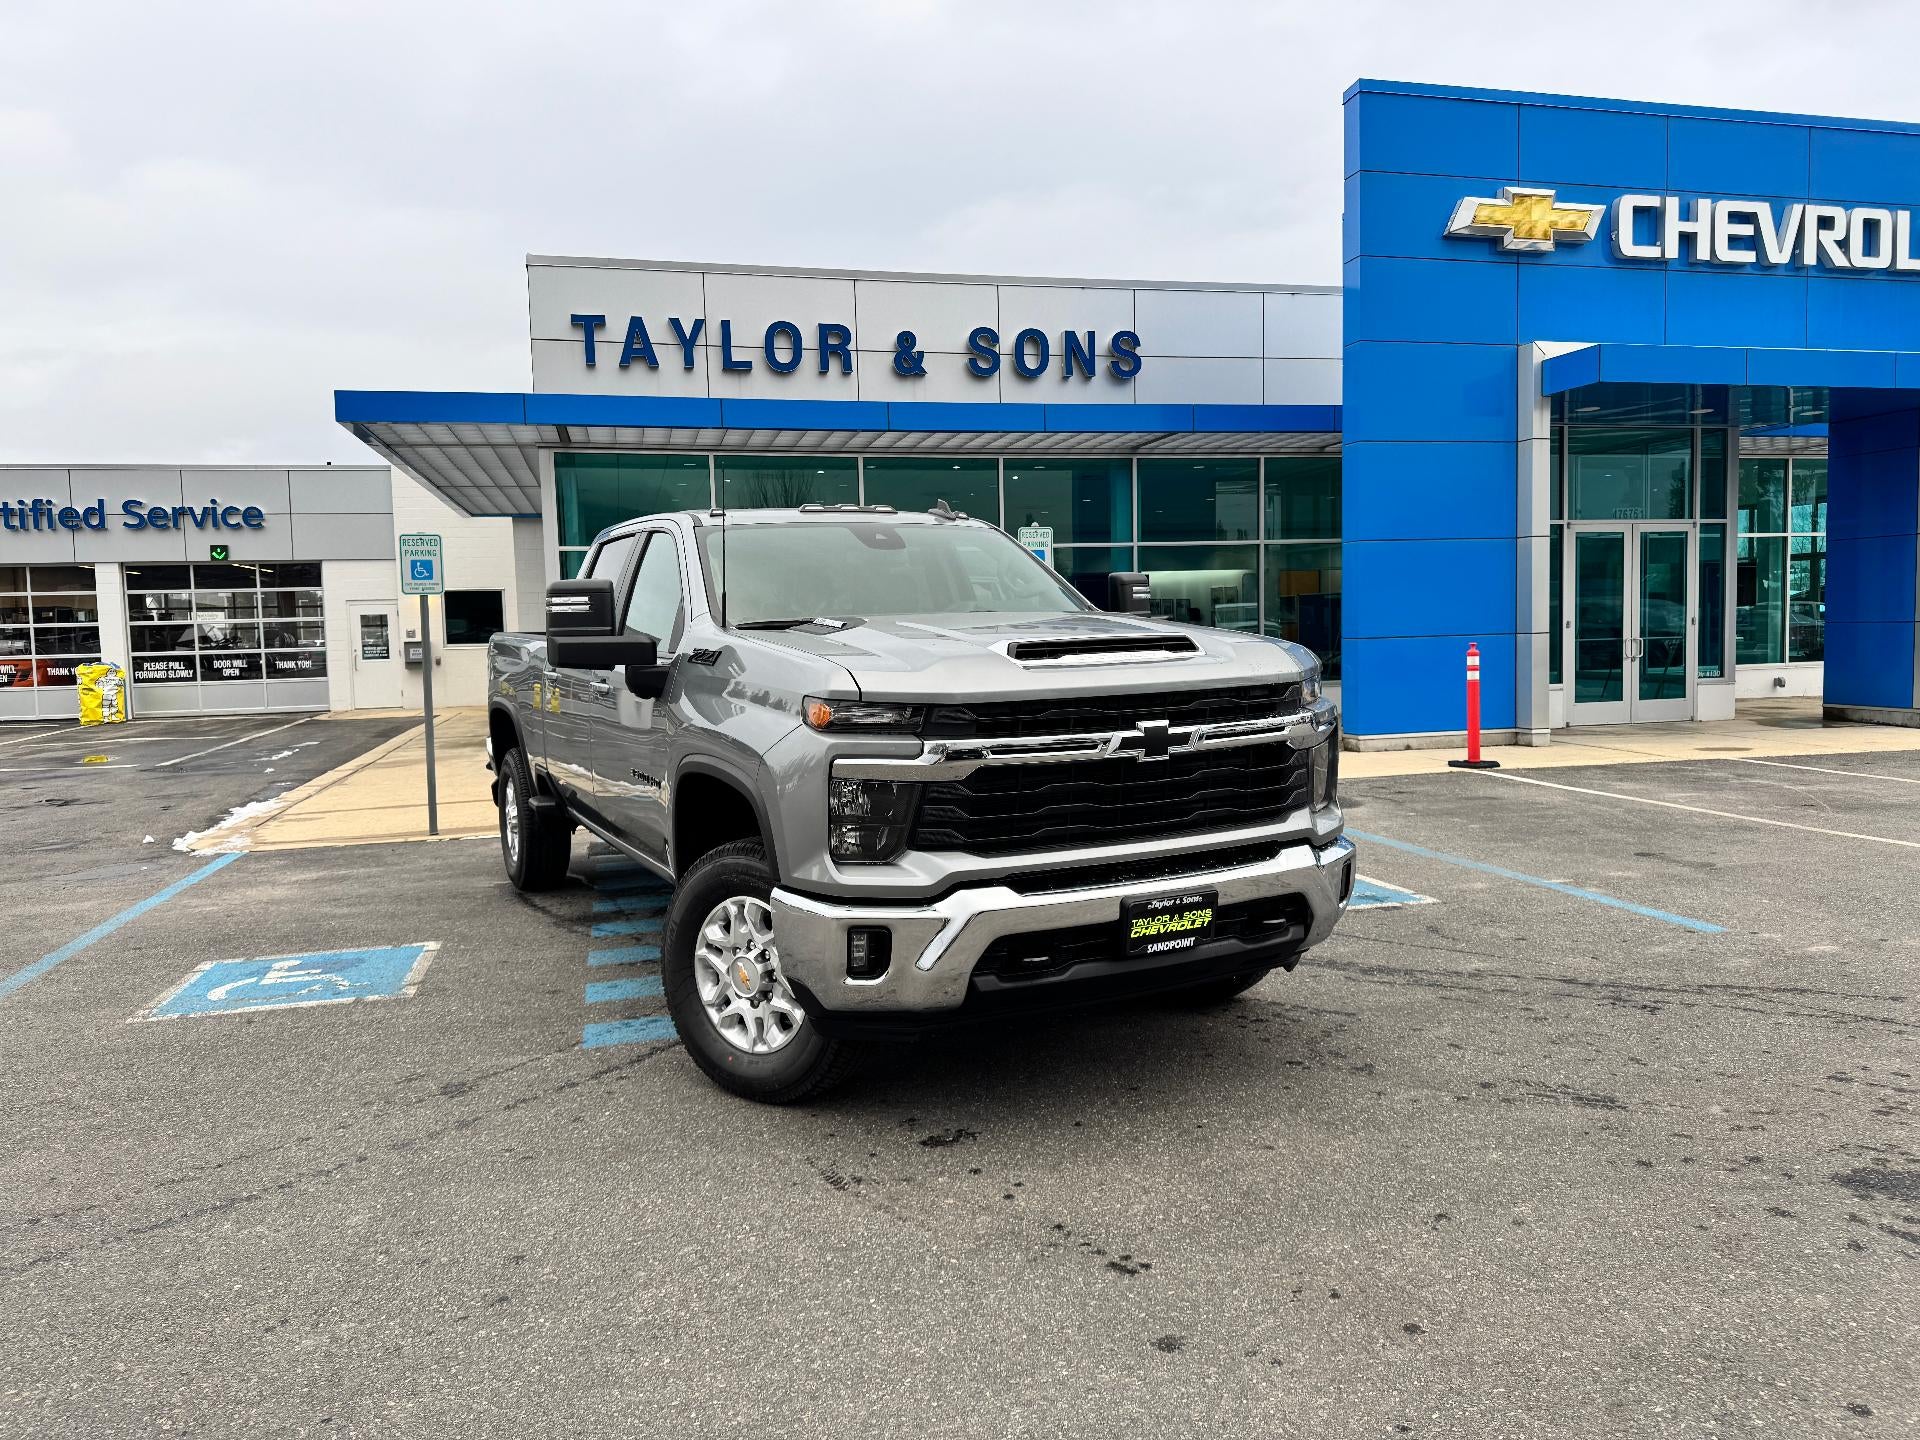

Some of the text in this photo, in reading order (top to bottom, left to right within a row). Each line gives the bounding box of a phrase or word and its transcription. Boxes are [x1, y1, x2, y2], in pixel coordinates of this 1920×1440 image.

[1611, 193, 1920, 270] CHEVROL
[570, 313, 1143, 379] TAYLOR & SONS
[0, 498, 265, 531] tified Service
[1021, 531, 1050, 539] RESERVED
[402, 538, 439, 547] RESERVED
[404, 549, 437, 557] PARKING
[143, 661, 186, 671] PLEASE PULL
[213, 659, 248, 669] DOOR WILL
[275, 660, 312, 669] THANK YOU!
[46, 667, 70, 676] THANK
[134, 669, 194, 679] FORWARD SLOWLY
[222, 668, 240, 677] OPEN
[1151, 899, 1175, 909] Taylor
[1131, 909, 1213, 928] TAYLOR & SONS
[1130, 917, 1212, 938] CHEVROLET
[1147, 937, 1196, 953] SANDPOINT
